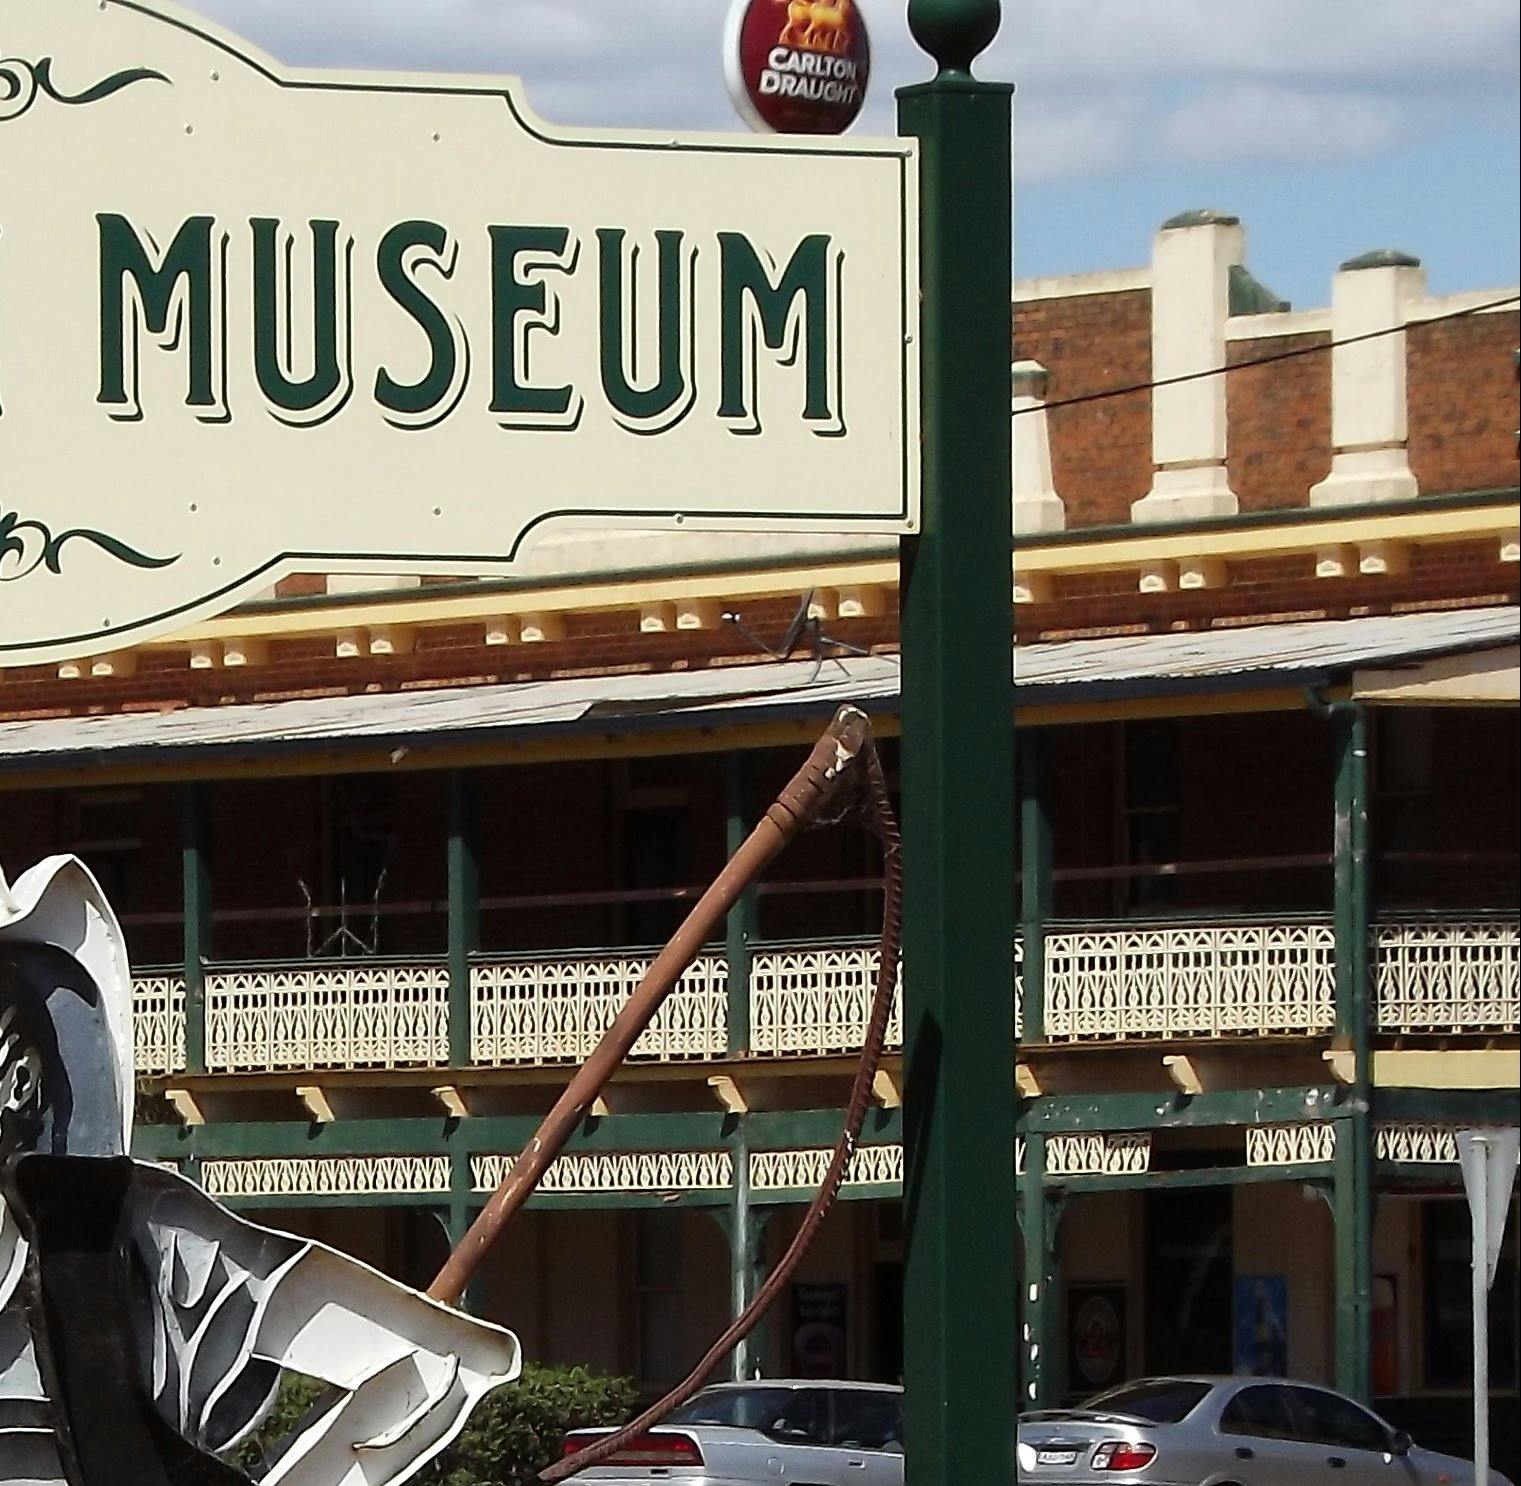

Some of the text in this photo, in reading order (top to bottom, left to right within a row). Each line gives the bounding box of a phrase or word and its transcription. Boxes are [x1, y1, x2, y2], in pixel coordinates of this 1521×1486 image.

[768, 47, 856, 80] CARLTON
[758, 70, 857, 103] DRAUGHT
[95, 212, 846, 437] MUSEUM
